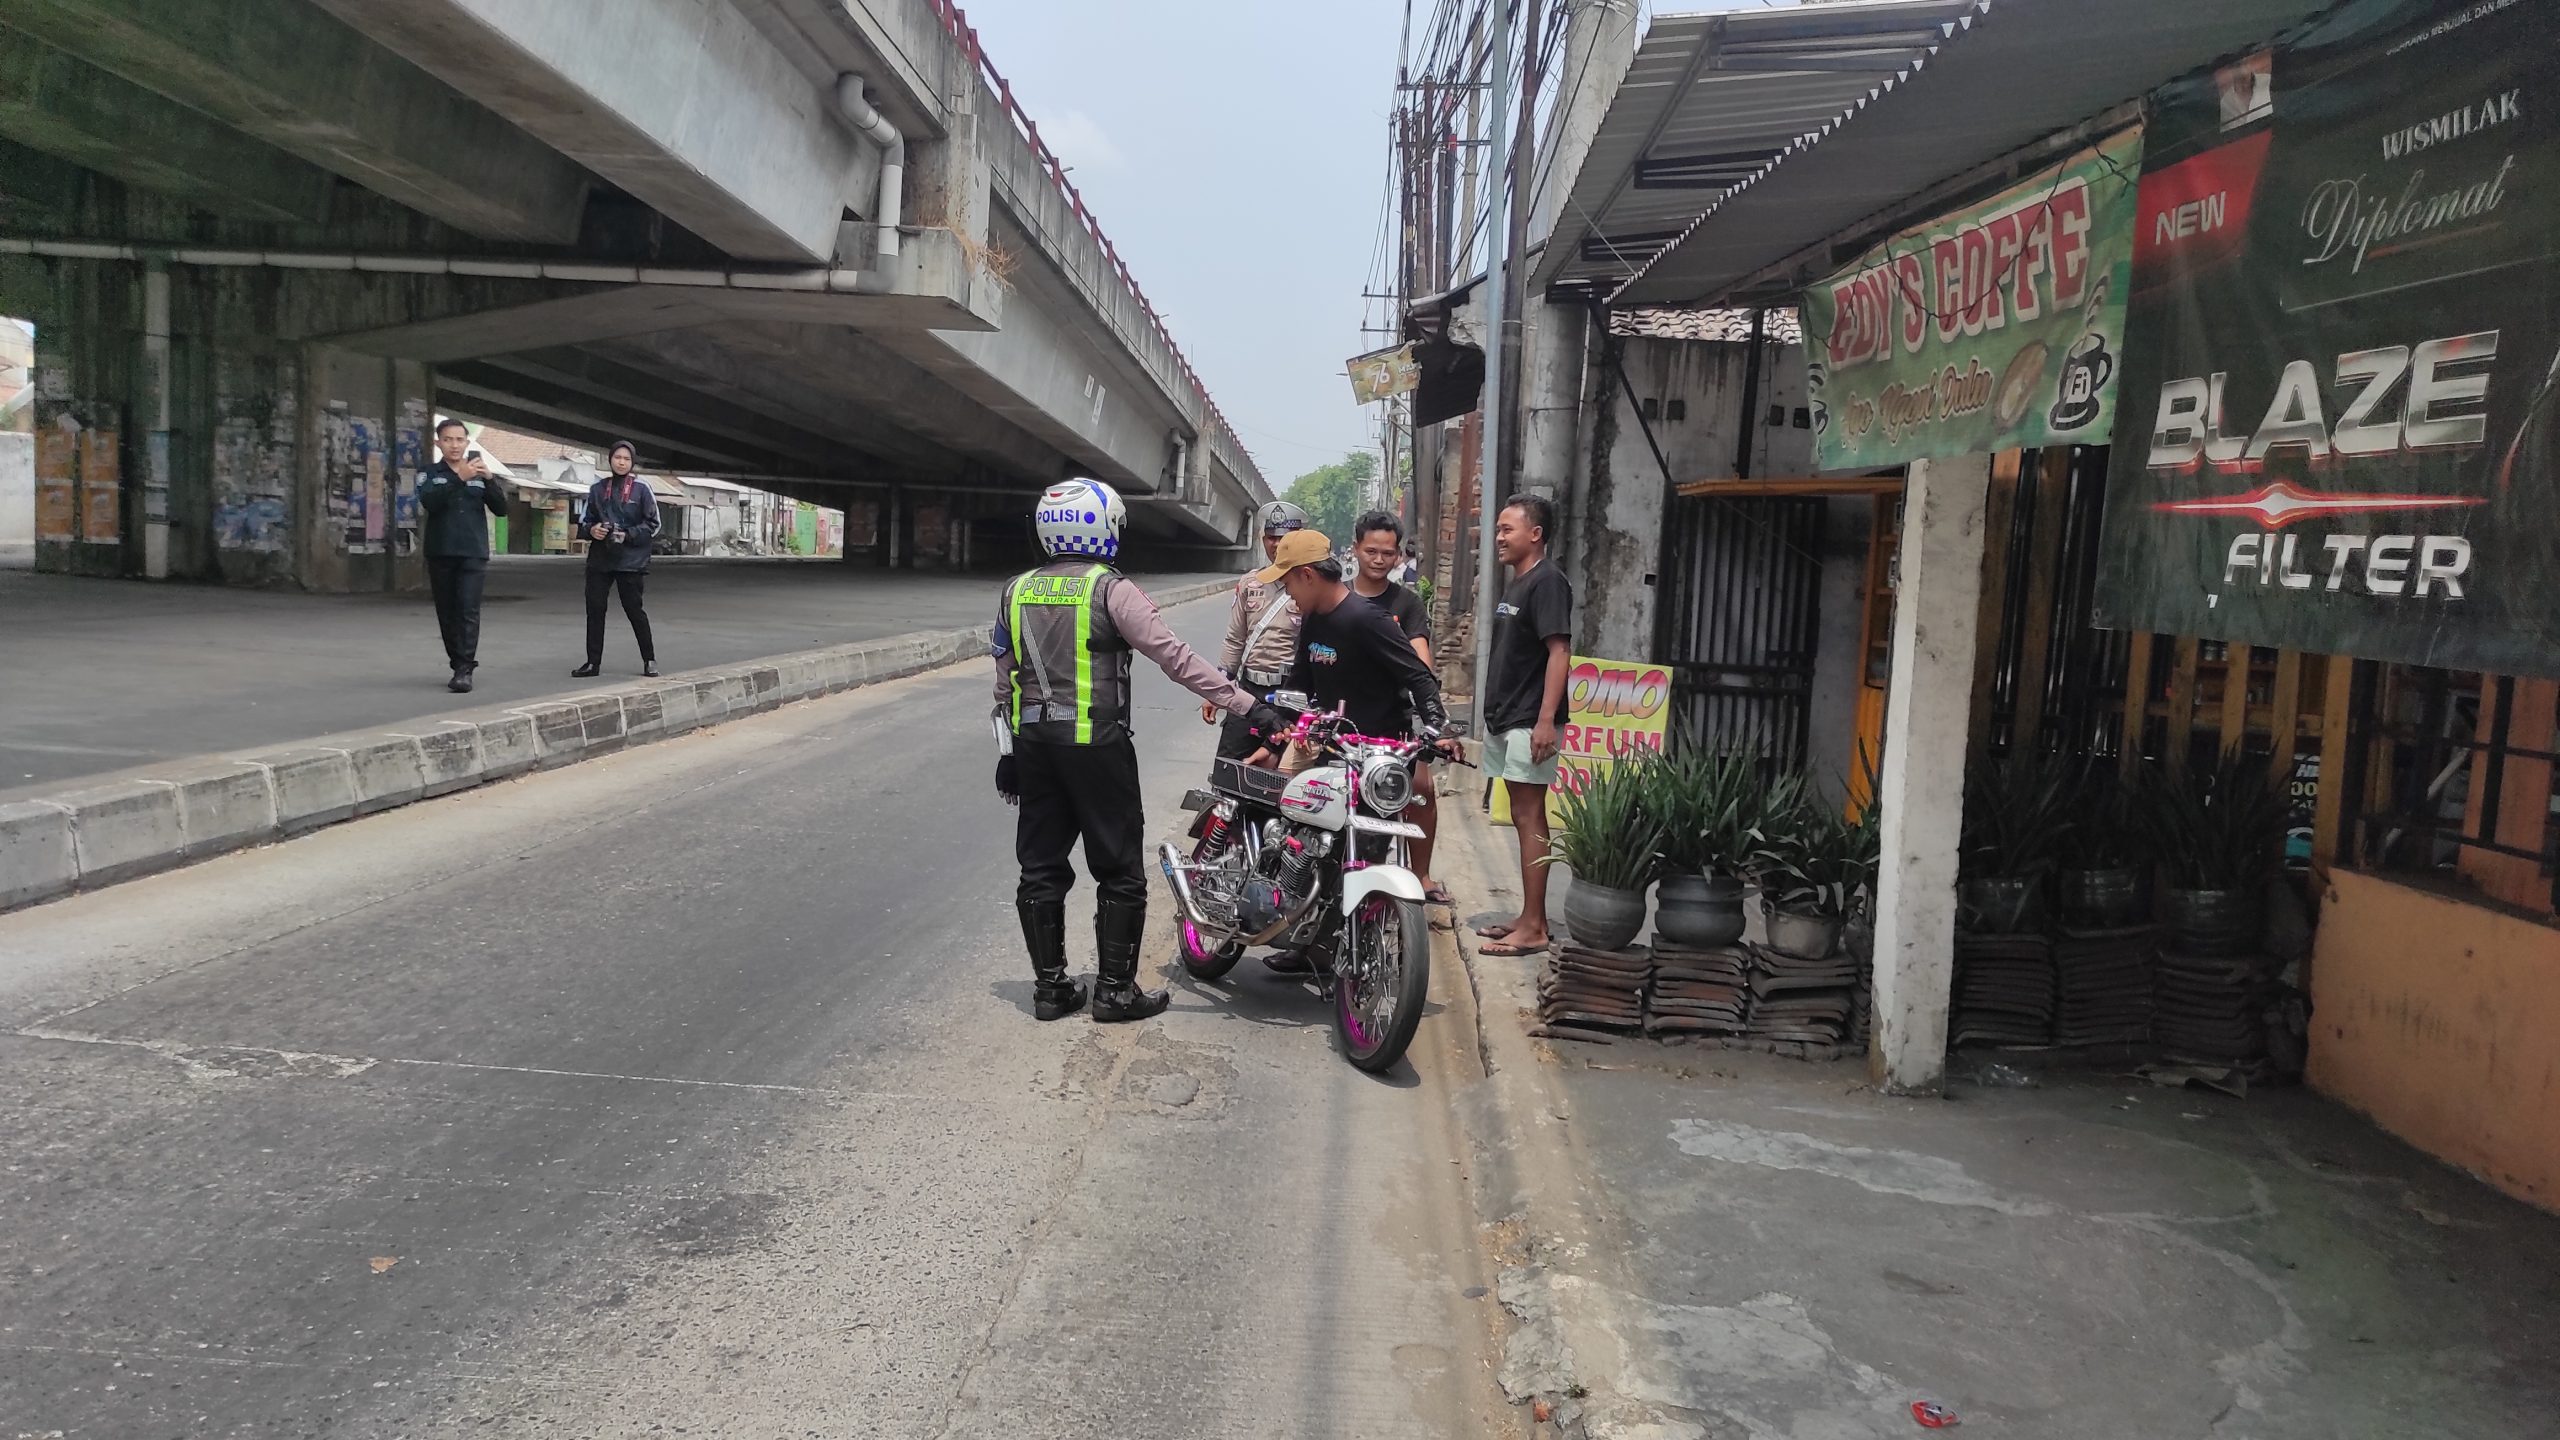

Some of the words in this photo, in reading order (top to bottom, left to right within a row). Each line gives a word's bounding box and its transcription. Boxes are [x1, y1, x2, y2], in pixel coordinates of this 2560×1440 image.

[2431, 12, 2473, 36] MENJUAL
[2474, 2, 2495, 20] DAN
[2382, 88, 2520, 160] WISMILAK
[2155, 191, 2226, 246] NEW
[2301, 154, 2514, 275] Diplomat
[1829, 250, 1926, 371] EDY'S
[1929, 176, 2092, 343] COFFE
[1940, 355, 1994, 421] Dulu
[2146, 330, 2499, 472] BLAZE
[1037, 509, 1079, 525] POLISI
[1020, 576, 1088, 597] POLISI
[2224, 533, 2472, 600] FILTER
[1569, 662, 1669, 720] OMO
[1561, 724, 1662, 757] RFUM
